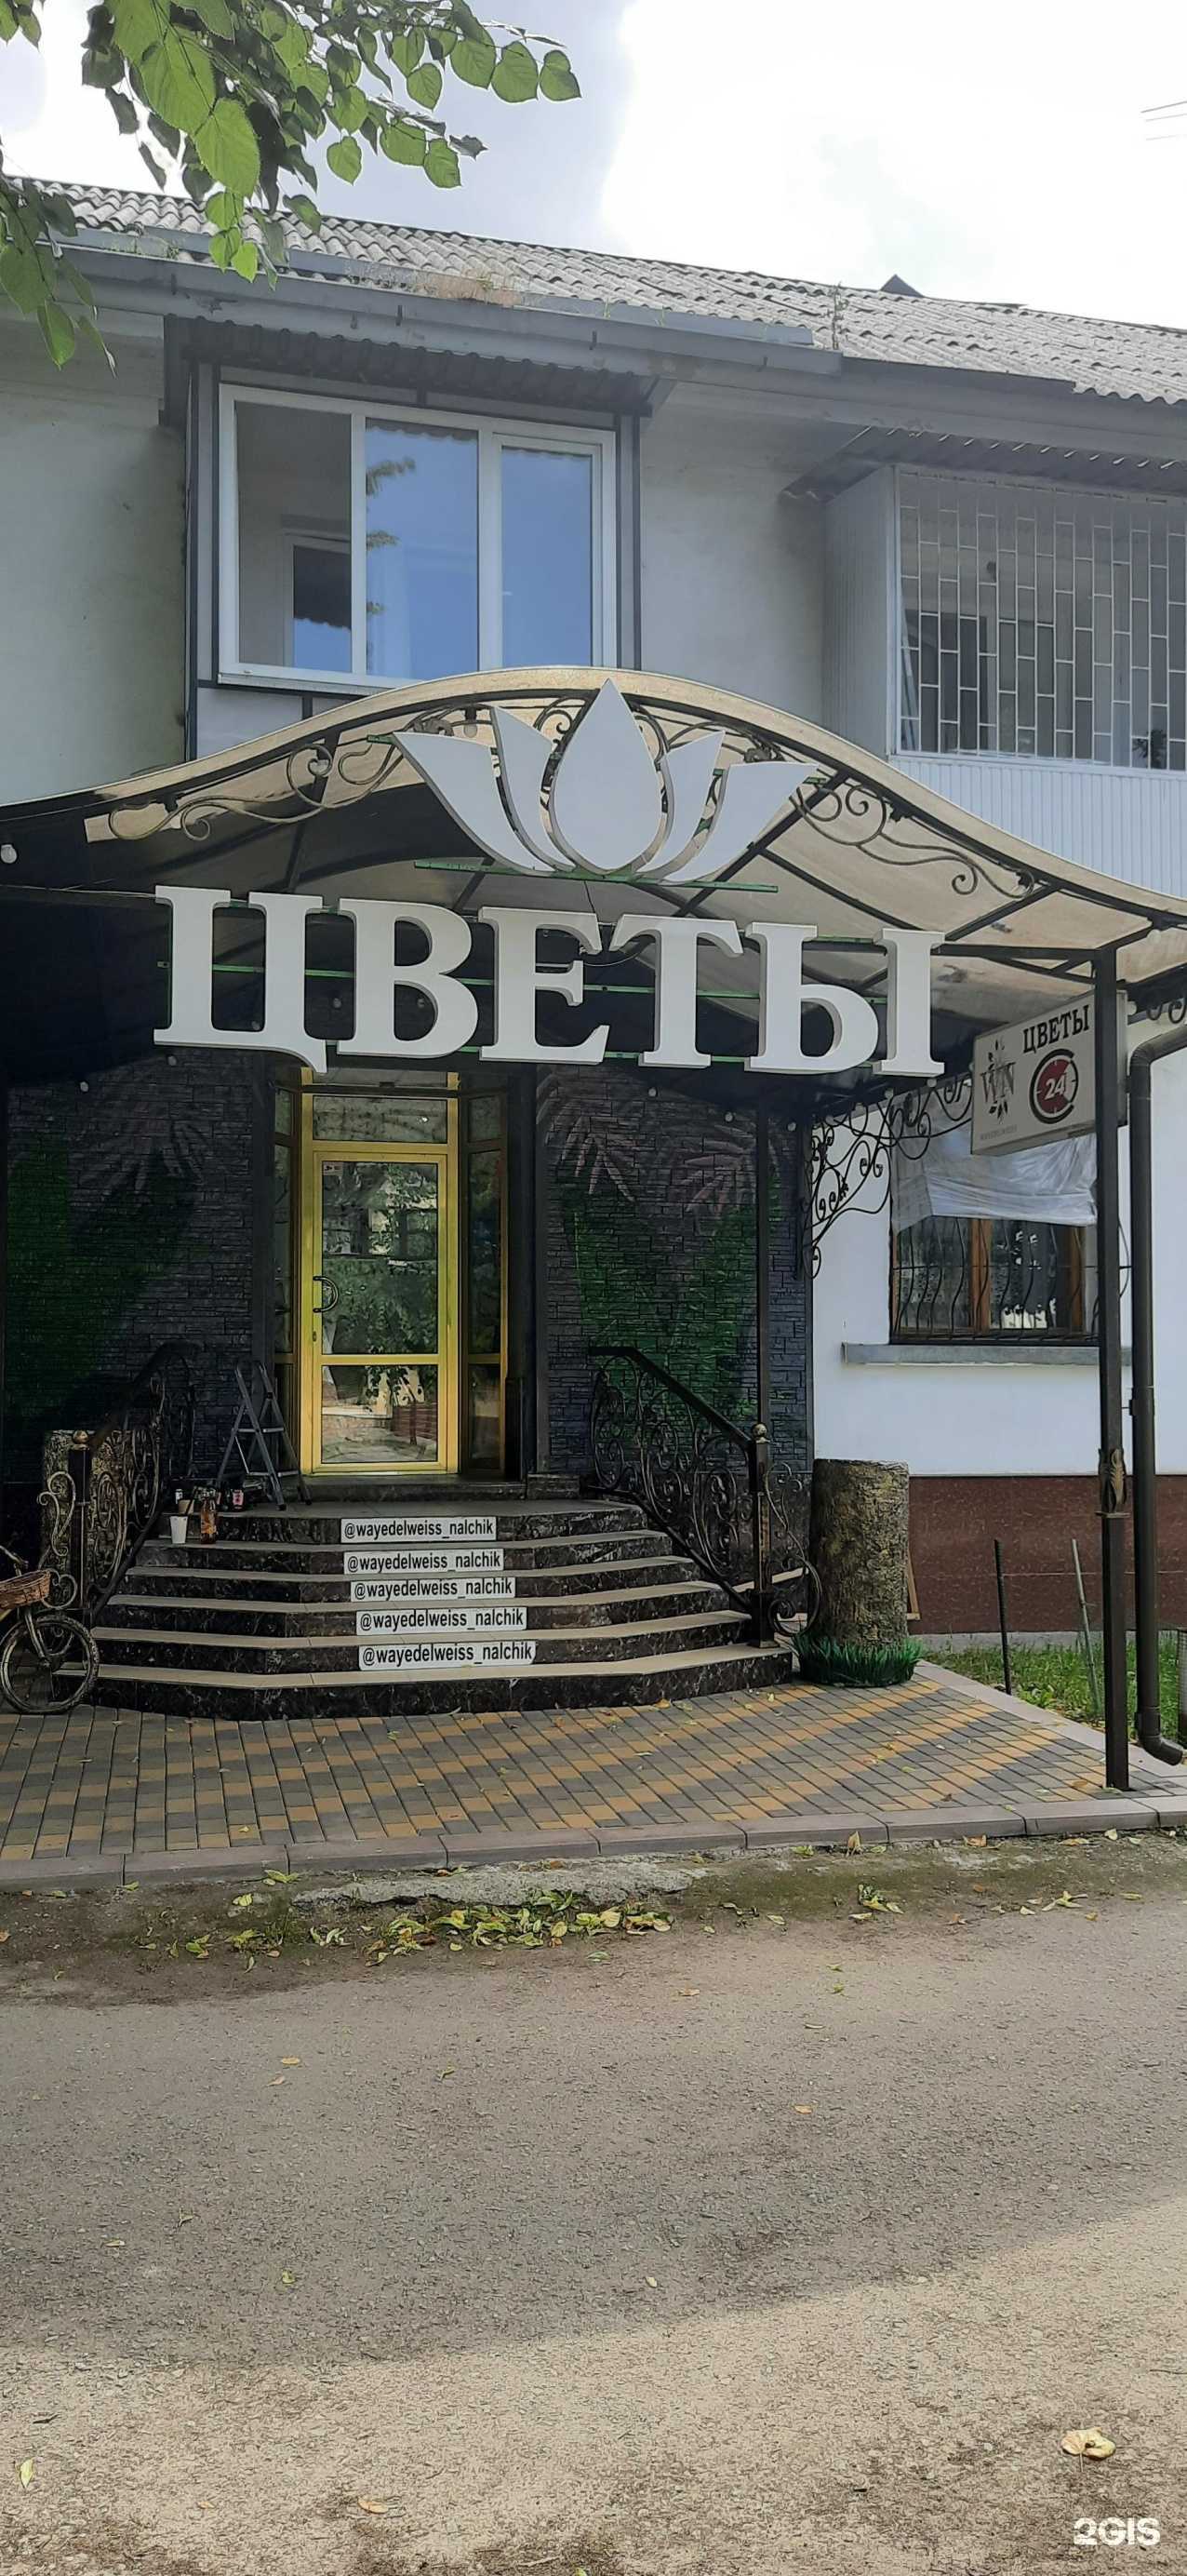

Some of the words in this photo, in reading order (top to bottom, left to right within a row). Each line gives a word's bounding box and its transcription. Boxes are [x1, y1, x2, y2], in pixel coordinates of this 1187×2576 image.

[153, 885, 945, 1078] ЦВЕТЫ
[1022, 1004, 1089, 1053] ЦВЕТЫ
[344, 1519, 493, 1539] @wayedelweiss_nalchik
[348, 1550, 500, 1572] @wayedelweiss_nalchik
[354, 1578, 512, 1601] @wayedelweiss_nalchik
[360, 1608, 524, 1631] @wayedelweiss_nalchik
[363, 1642, 532, 1667] @wayedelweiss_nalchik
